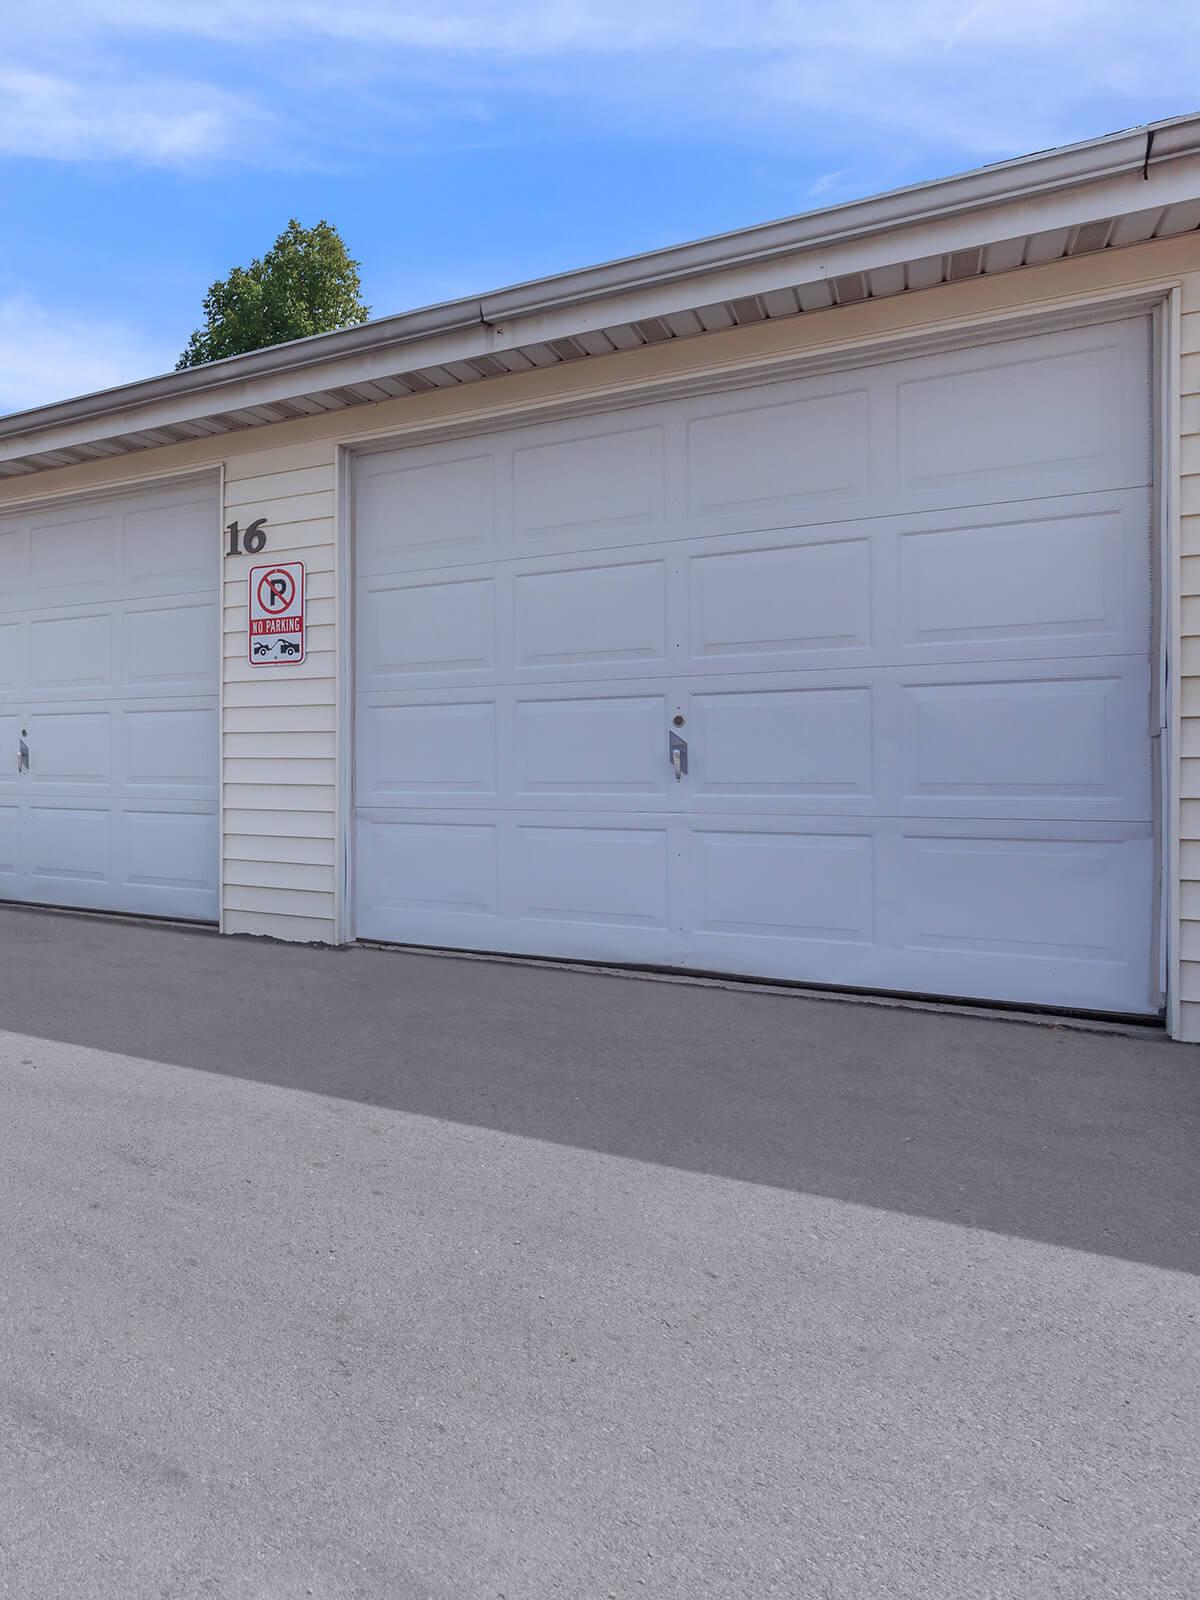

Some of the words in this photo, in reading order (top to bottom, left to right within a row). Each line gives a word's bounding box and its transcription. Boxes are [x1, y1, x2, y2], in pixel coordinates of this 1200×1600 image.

[226, 518, 268, 556] 16
[252, 620, 263, 633] NO
[265, 617, 300, 633] PARKING
